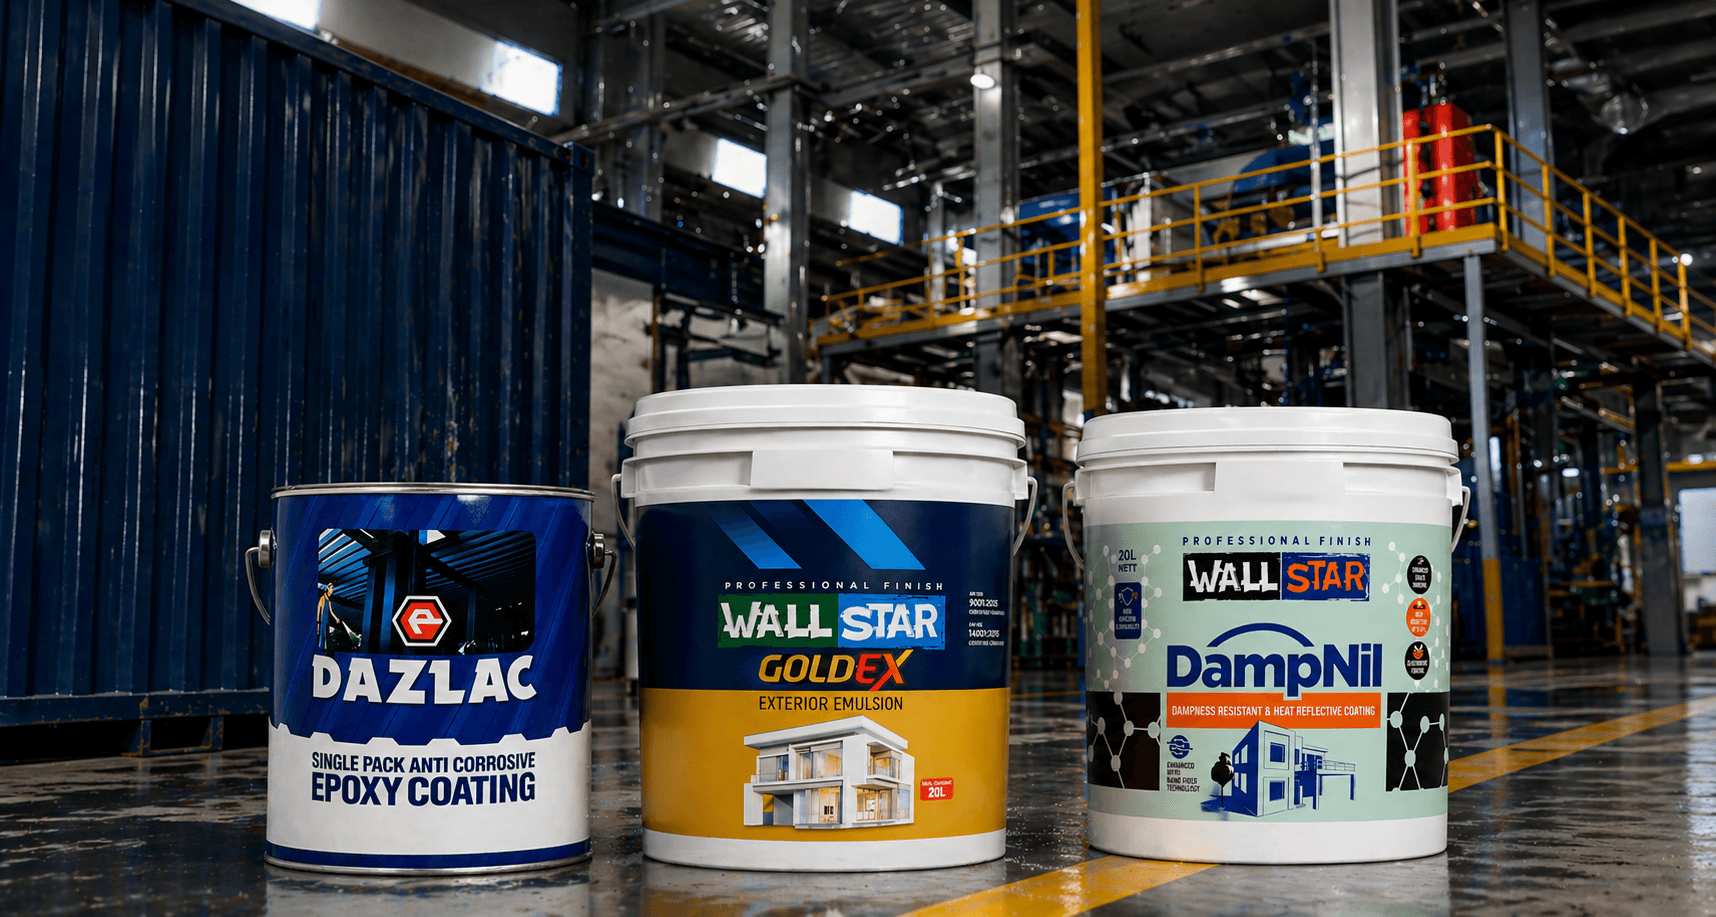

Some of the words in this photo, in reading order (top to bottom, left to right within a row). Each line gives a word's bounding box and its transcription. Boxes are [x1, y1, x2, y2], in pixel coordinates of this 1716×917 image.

[1183, 536, 1310, 546] PROFESSIONAL
[1319, 536, 1371, 547] FINISH
[1118, 549, 1137, 561] 20L
[1118, 563, 1137, 573] NETT
[1187, 559, 1278, 593] WALL
[1286, 560, 1365, 593] STAR
[724, 581, 870, 590] PROFESSIONAL
[883, 582, 943, 591] FINISH
[720, 601, 833, 639] WALL
[840, 603, 938, 641] STAR
[758, 649, 914, 691] GOLDEX
[1166, 643, 1383, 698] DampNil
[312, 654, 538, 705] DAZLAC
[759, 696, 828, 711] EXTERIOR
[833, 696, 903, 711] EMULSION
[1171, 705, 1216, 716] DAMPNESS
[1218, 706, 1263, 716] RESISTANT
[1265, 706, 1271, 716] &
[1273, 706, 1294, 716] HEAT
[1296, 706, 1342, 716] REFLECTIVE
[1344, 705, 1376, 716] COATING
[312, 751, 359, 771] SINGLE
[363, 756, 405, 773] PACK
[409, 757, 448, 773] ANTI
[452, 751, 536, 773] CORROSIVE
[311, 771, 403, 806] EPOXY
[407, 771, 536, 807] COATING
[928, 786, 946, 798] 20L
